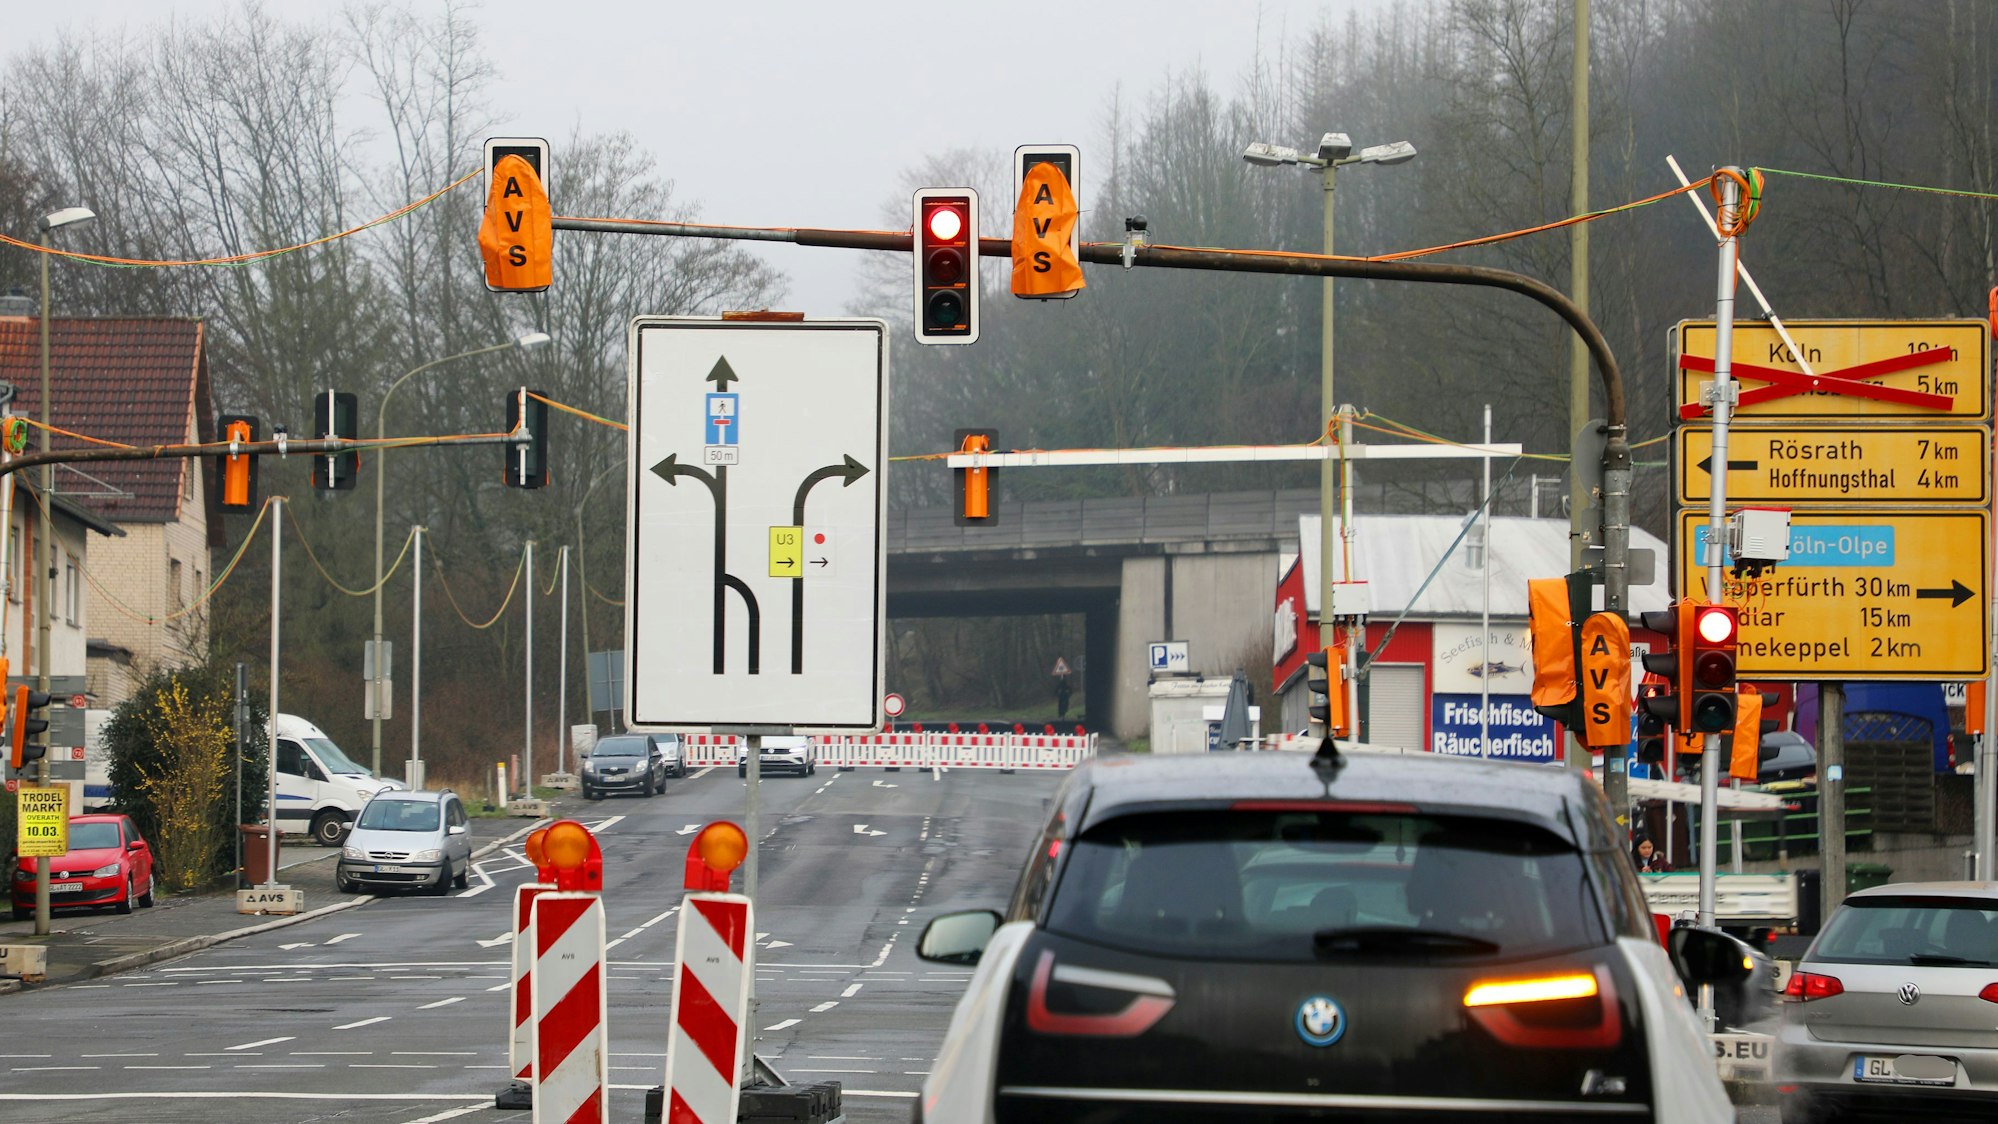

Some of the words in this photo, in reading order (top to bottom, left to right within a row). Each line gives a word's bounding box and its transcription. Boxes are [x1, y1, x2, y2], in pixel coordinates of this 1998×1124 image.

[503, 176, 527, 267] AVS
[1033, 183, 1054, 273] AVS
[1918, 375, 1930, 393] 5
[1935, 377, 1958, 395] km
[710, 450, 723, 461] 50
[724, 452, 734, 461] m
[1769, 440, 1863, 460] Rösrath
[1917, 440, 1930, 460] 7
[1934, 443, 1958, 460] km
[1769, 469, 1896, 493] Hoffnungsthal
[1917, 470, 1930, 489] 4
[1934, 471, 1959, 489] km
[776, 533, 795, 546] U3
[1788, 536, 1888, 559] öln-Olpe
[1855, 577, 1883, 597] 30
[1887, 579, 1910, 597] km
[1737, 607, 1785, 627] dlar
[1861, 608, 1883, 627] 15
[1887, 610, 1910, 627] km
[1441, 633, 1498, 664] Seefish
[1504, 633, 1514, 645] &
[1736, 637, 1850, 662] mekeppel
[1871, 638, 1883, 657] 2
[1887, 638, 1921, 658] km
[1590, 635, 1611, 725] AVS
[1434, 733, 1553, 758] Räucherfisch
[22, 803, 63, 812] MARKT
[26, 826, 60, 837] 10.03.
[259, 894, 284, 903] AVS
[1715, 1040, 1768, 1059] S.EU
[1870, 1060, 1891, 1076] GL
